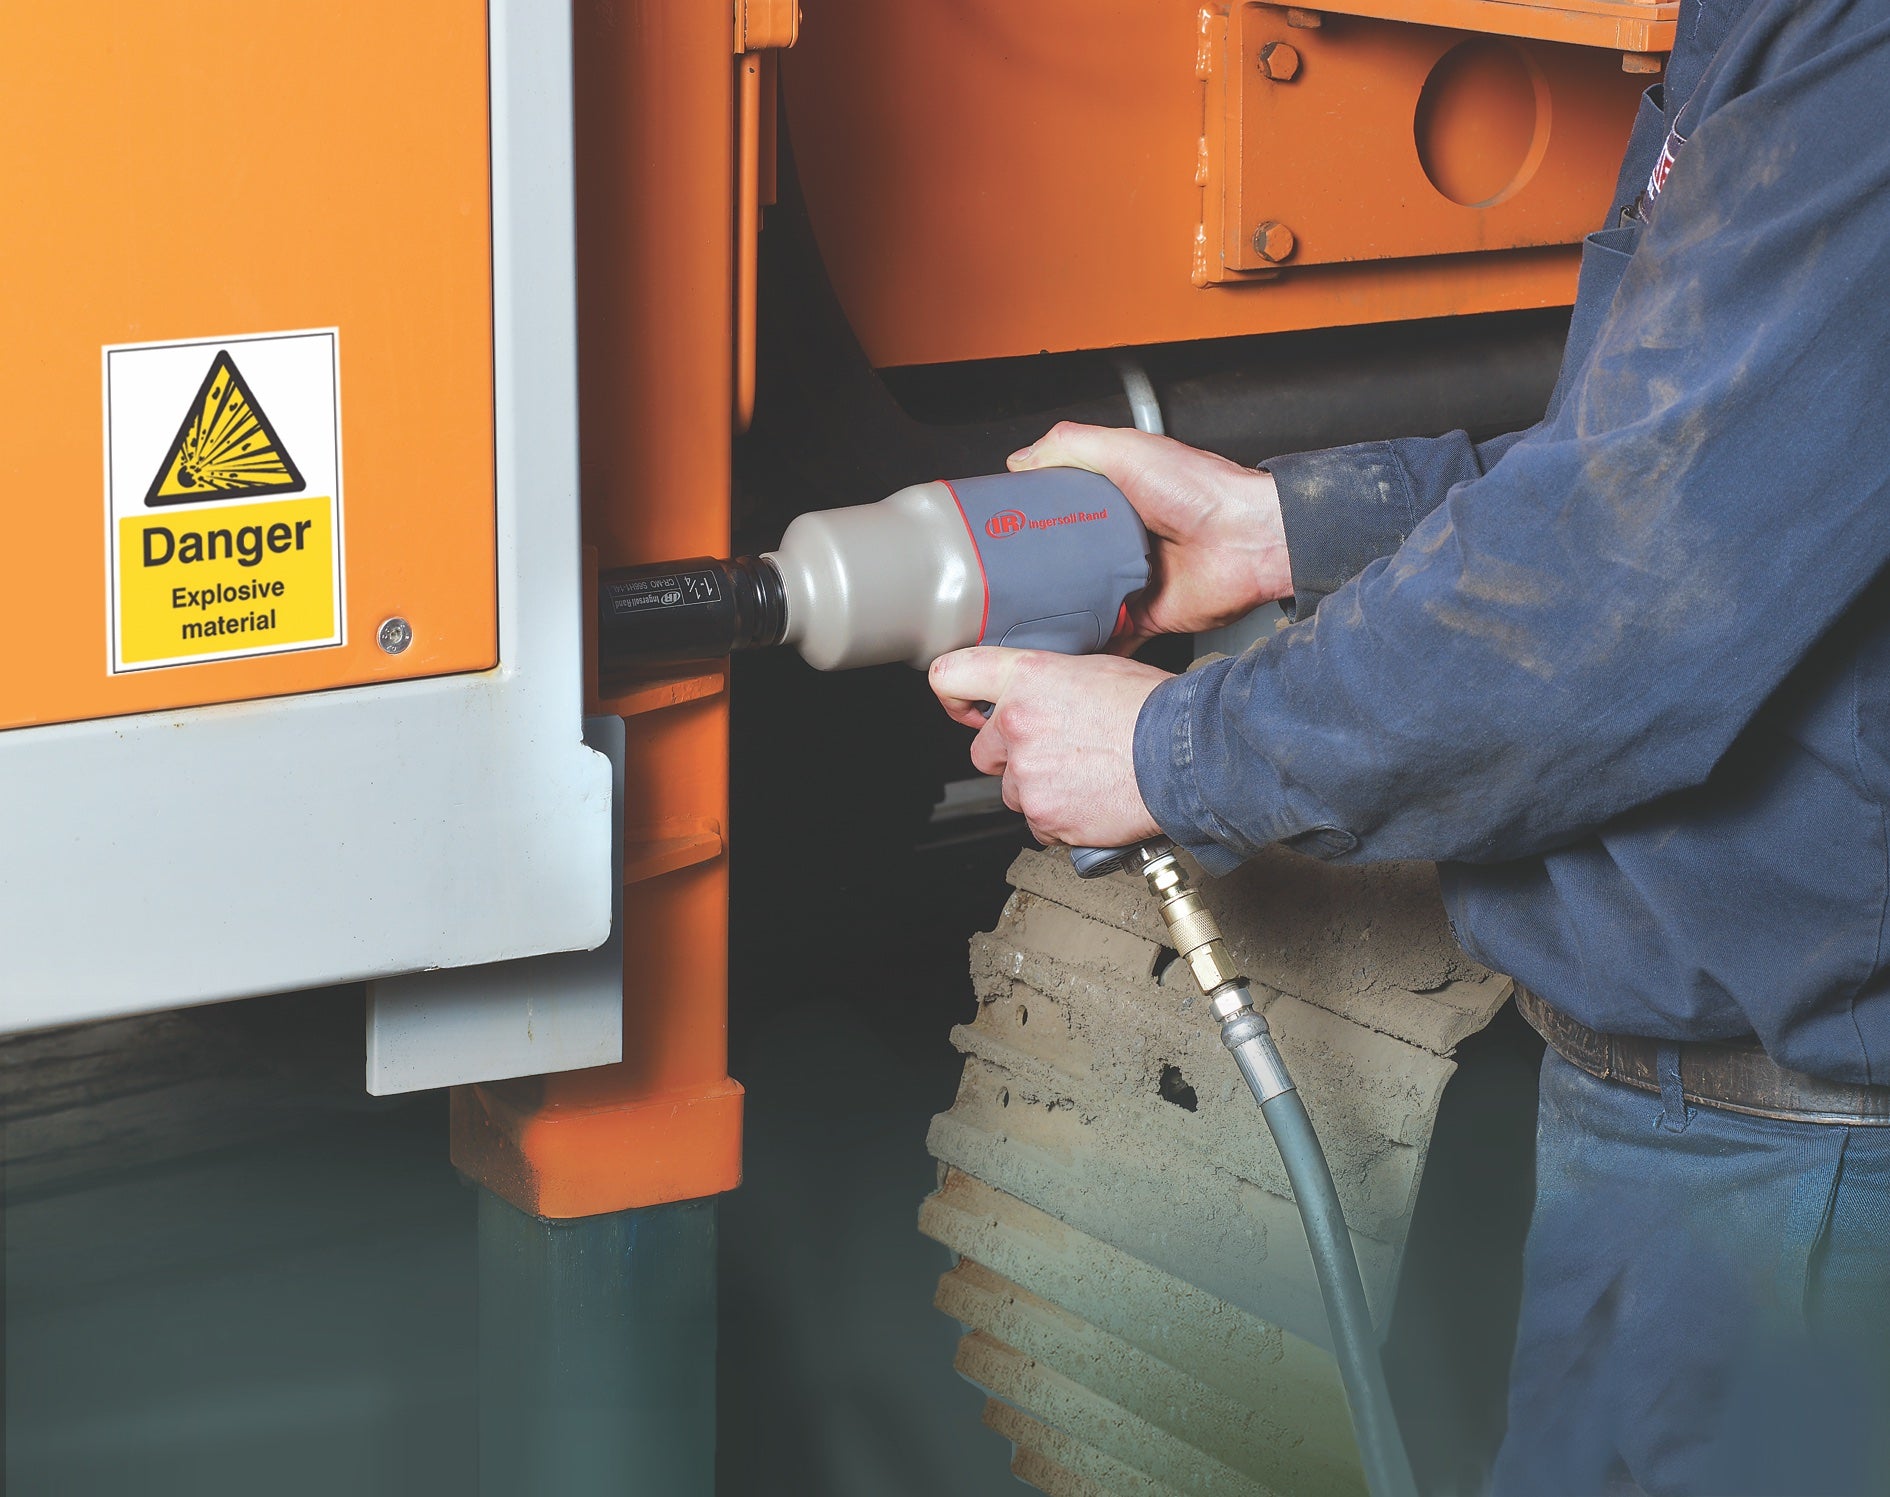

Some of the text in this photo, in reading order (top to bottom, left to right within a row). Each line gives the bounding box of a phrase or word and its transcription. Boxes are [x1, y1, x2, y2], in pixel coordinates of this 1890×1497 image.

[1029, 512, 1077, 530] Ingersoll
[1079, 508, 1108, 523] Rand
[142, 519, 311, 567] Danger
[650, 578, 675, 588] CR-MO
[172, 579, 285, 610] Explosive
[615, 599, 631, 609] Rand
[633, 594, 660, 605] Ingersoll
[182, 609, 276, 639] material
